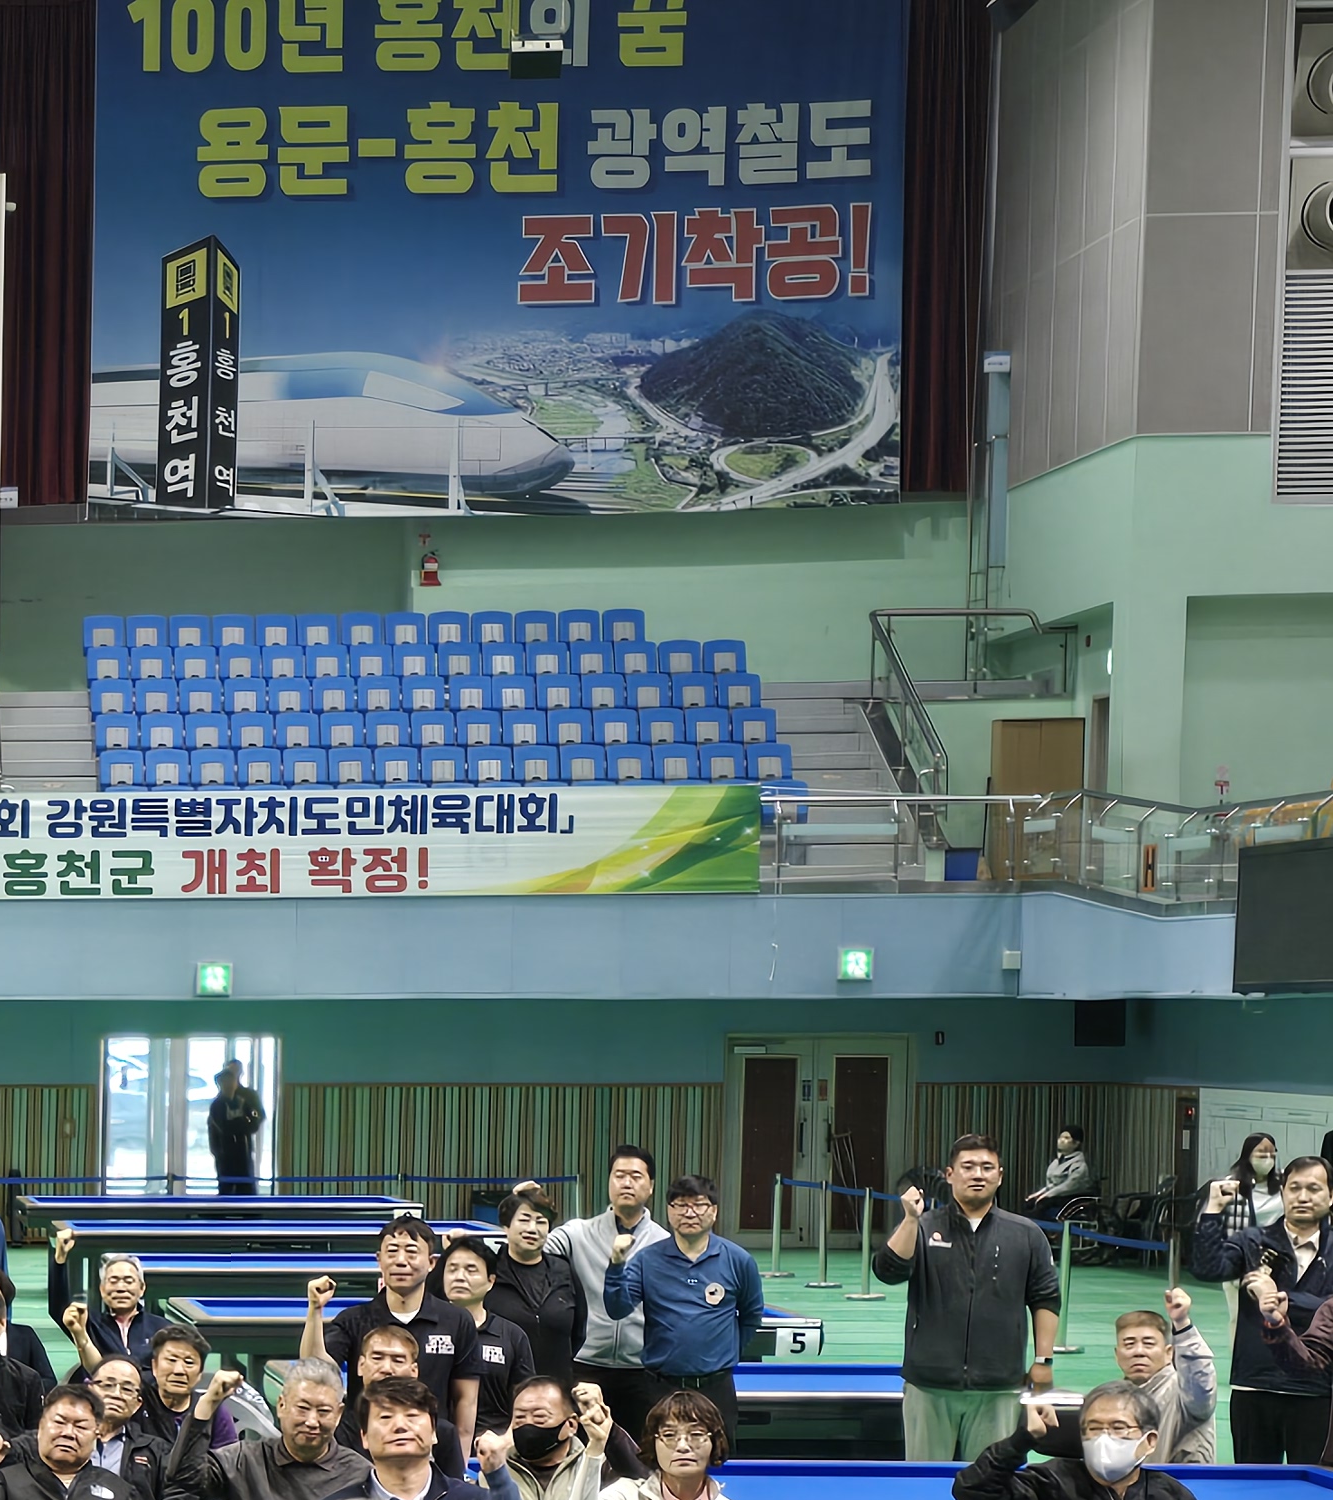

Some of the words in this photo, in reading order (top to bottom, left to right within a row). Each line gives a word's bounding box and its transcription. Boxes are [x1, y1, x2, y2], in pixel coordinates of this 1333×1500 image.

[129, 0, 343, 73] 100년
[374, 0, 589, 71] 홍천의
[197, 102, 559, 198] 용문-홍천
[588, 100, 872, 189] 광역철도
[517, 203, 872, 305] 조기착공!
[178, 307, 190, 336] 1
[164, 340, 201, 498] 홍천역
[2, 848, 155, 896] 홍천군
[181, 847, 281, 895] 개최
[307, 847, 429, 894] 확정!
[790, 1332, 806, 1354] 5
